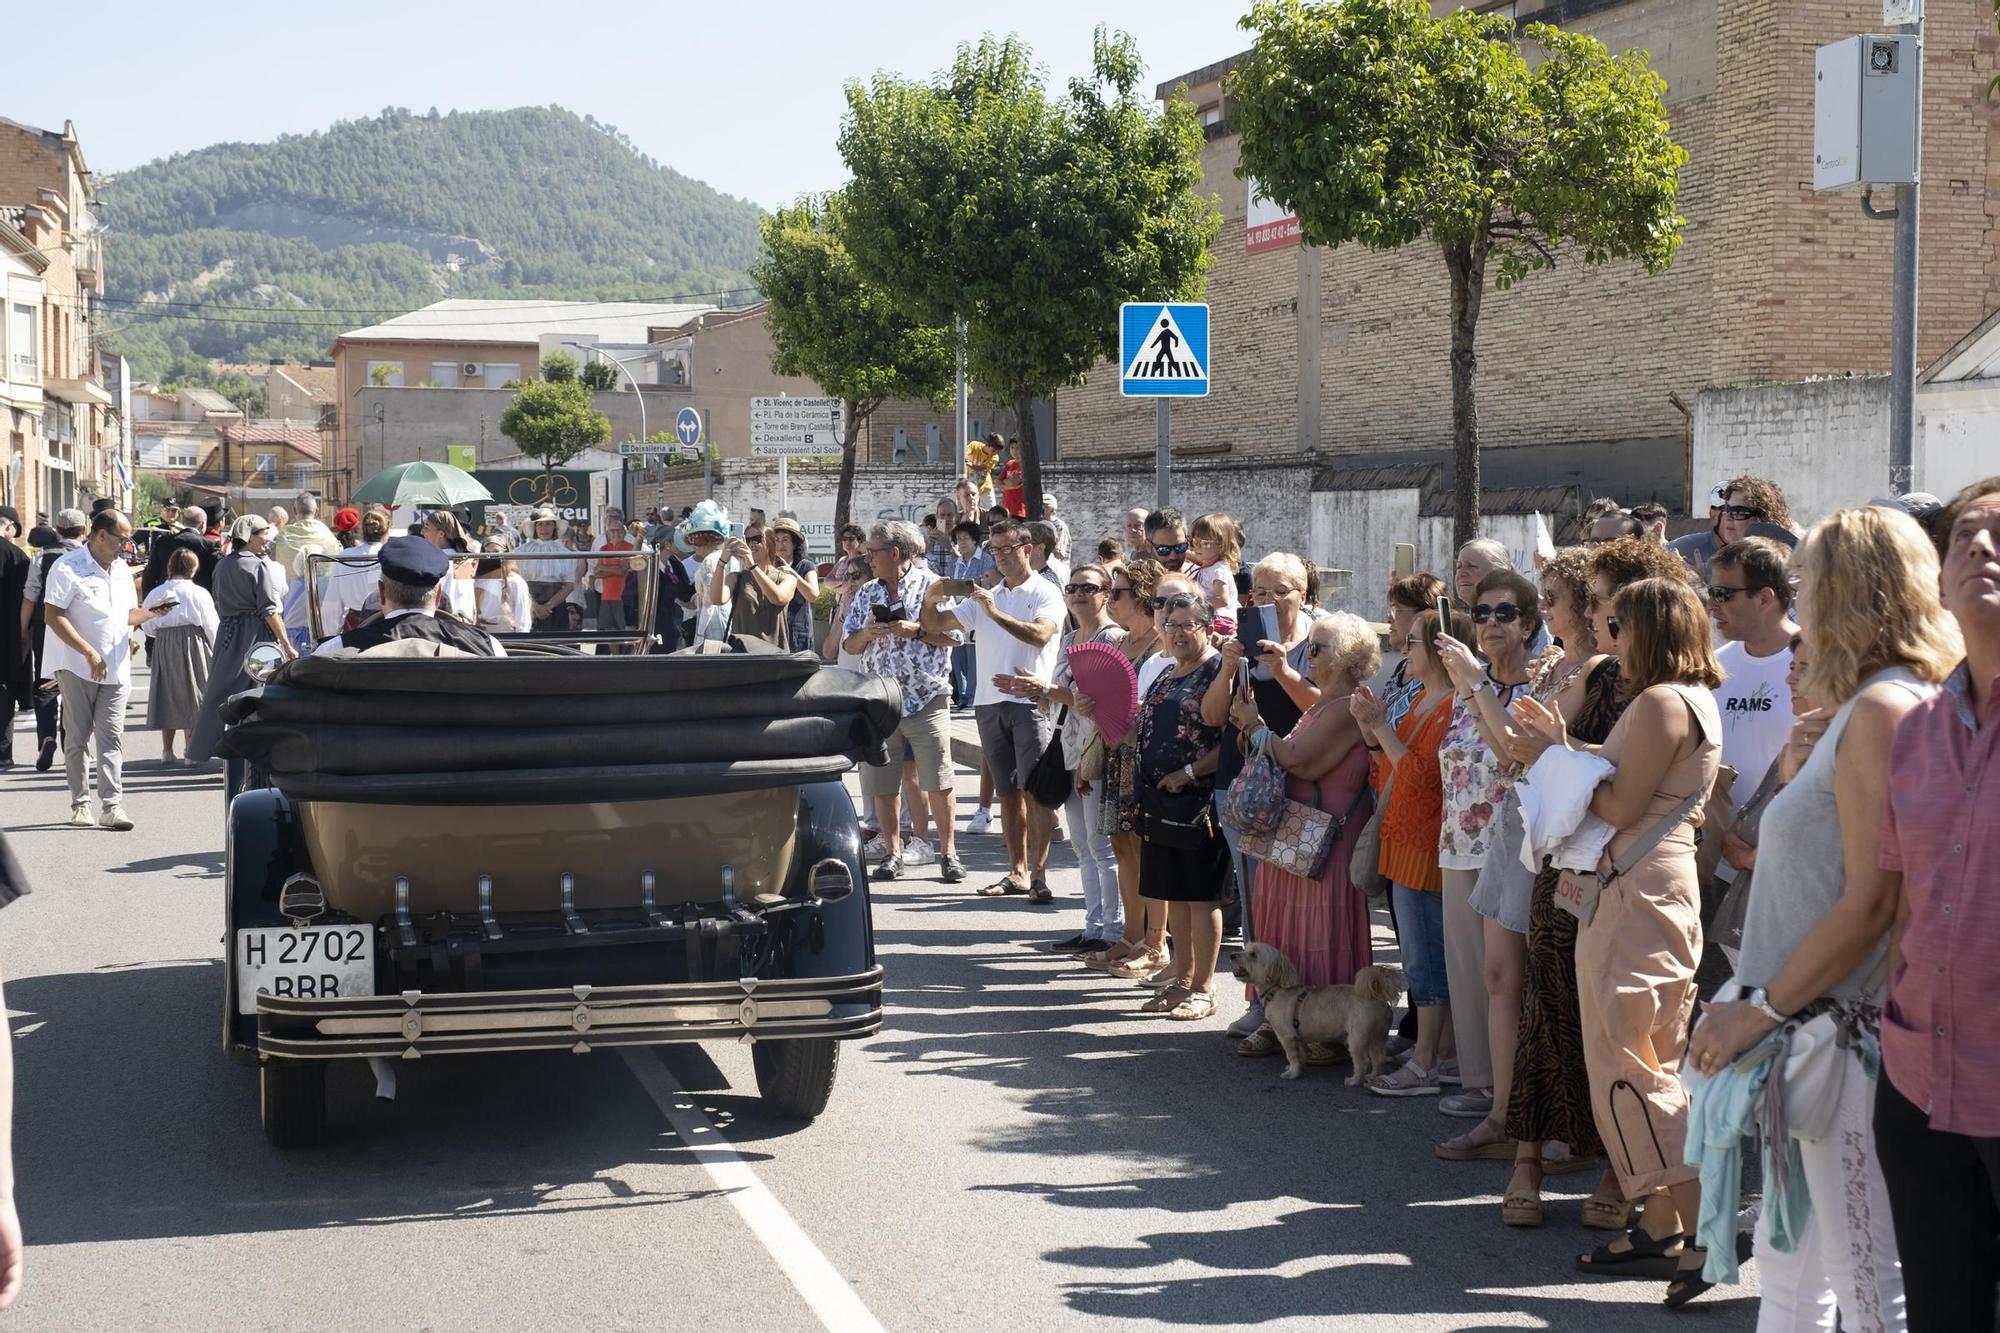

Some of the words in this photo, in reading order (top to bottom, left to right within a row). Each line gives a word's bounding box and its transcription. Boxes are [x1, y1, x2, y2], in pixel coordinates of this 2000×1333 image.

[763, 399, 771, 407] St.
[773, 399, 793, 408] Vicenç
[794, 399, 801, 407] de
[763, 422, 779, 430] Torre
[780, 422, 789, 430] del
[790, 422, 807, 431] Breny
[763, 434, 802, 442] Deixalleria
[779, 447, 810, 455] polivalent
[1725, 697, 1773, 711] RAMS
[246, 934, 266, 965] H
[278, 930, 365, 963] 2702
